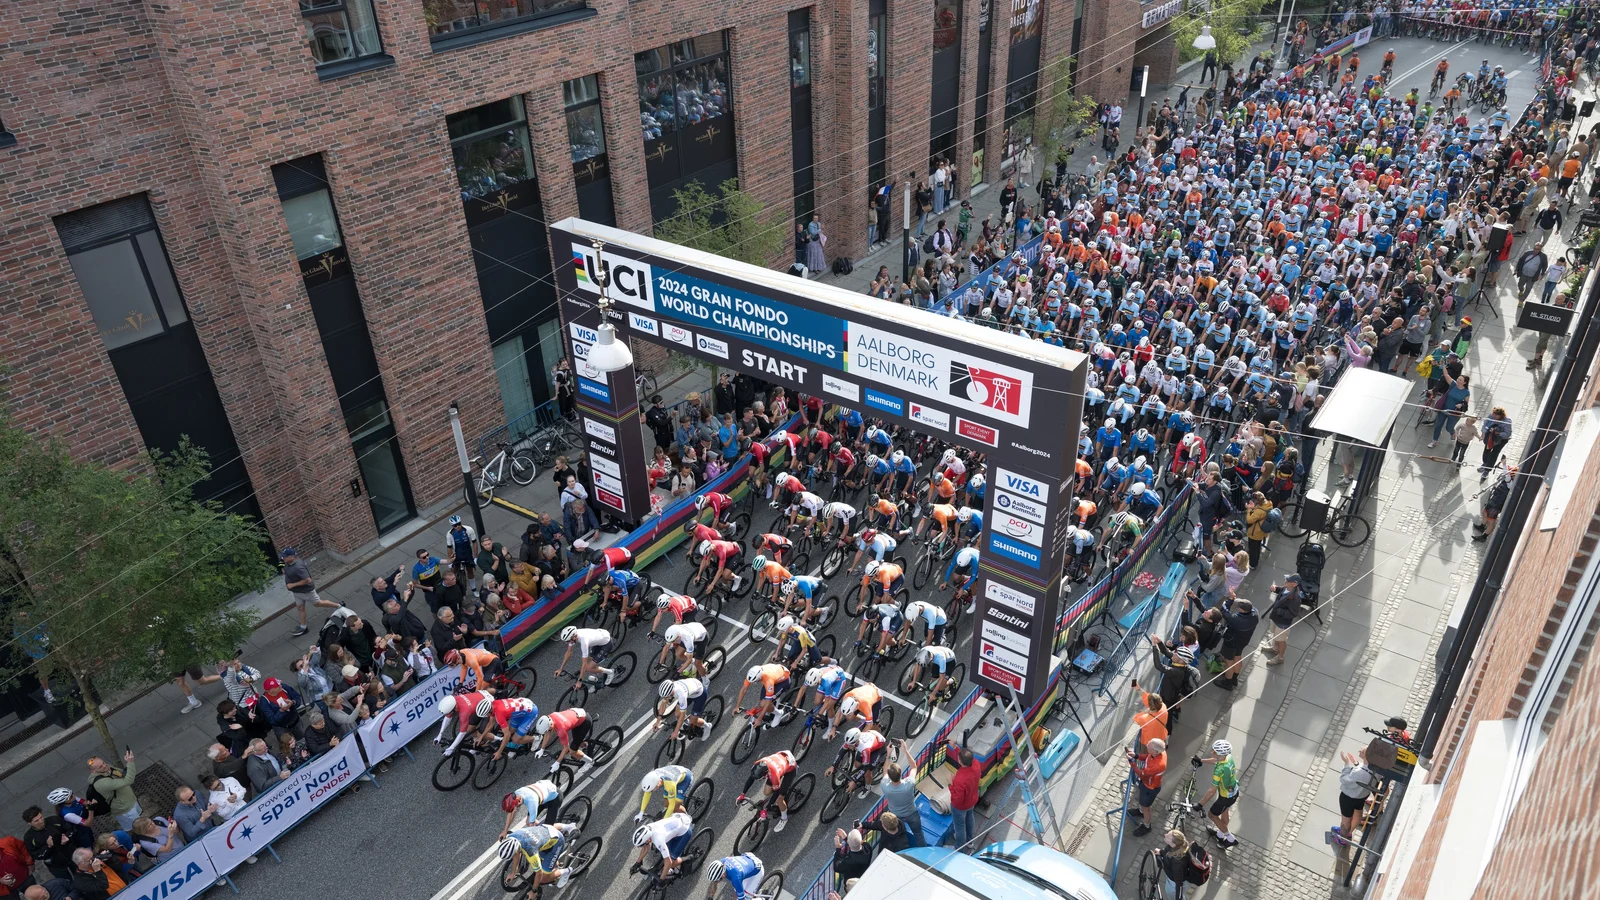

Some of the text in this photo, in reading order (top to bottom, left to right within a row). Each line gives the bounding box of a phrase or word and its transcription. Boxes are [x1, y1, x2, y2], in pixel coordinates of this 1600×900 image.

[585, 254, 649, 301] UCI
[658, 276, 789, 326] 2024 GRAN FONDO
[634, 316, 654, 331] VISA
[660, 293, 836, 360] WORLD CHAMPIONSHIPS
[1540, 313, 1562, 323] STUDIO
[576, 327, 597, 342] VISA
[672, 327, 683, 335] DCU
[857, 334, 936, 369] AALBORG
[742, 349, 808, 384] START
[857, 353, 939, 391] DENMARK
[580, 382, 608, 398] SHIMANO
[867, 394, 901, 410] SHIMANO
[964, 423, 991, 436] SPORT EVENT
[966, 430, 987, 440] DENMARK
[590, 440, 616, 456] Santini
[1011, 441, 1051, 459] #Aalborg2024
[1005, 473, 1040, 497] VISA
[1012, 499, 1036, 512] Aalborg
[1012, 504, 1042, 519] Kommune
[1008, 518, 1028, 529] DCU
[993, 539, 1037, 561] SHIMANO
[1000, 591, 1033, 609] spar Nord
[987, 606, 1030, 629] Santini
[995, 655, 1024, 671] spar Nord
[987, 666, 1016, 681] SPORT EVENT
[403, 674, 449, 709] Powered by
[406, 690, 440, 723] spar
[258, 770, 313, 812] Powered by
[260, 755, 348, 825] spar Nord
[309, 769, 351, 802] FONDEN
[137, 861, 203, 900] VISA
